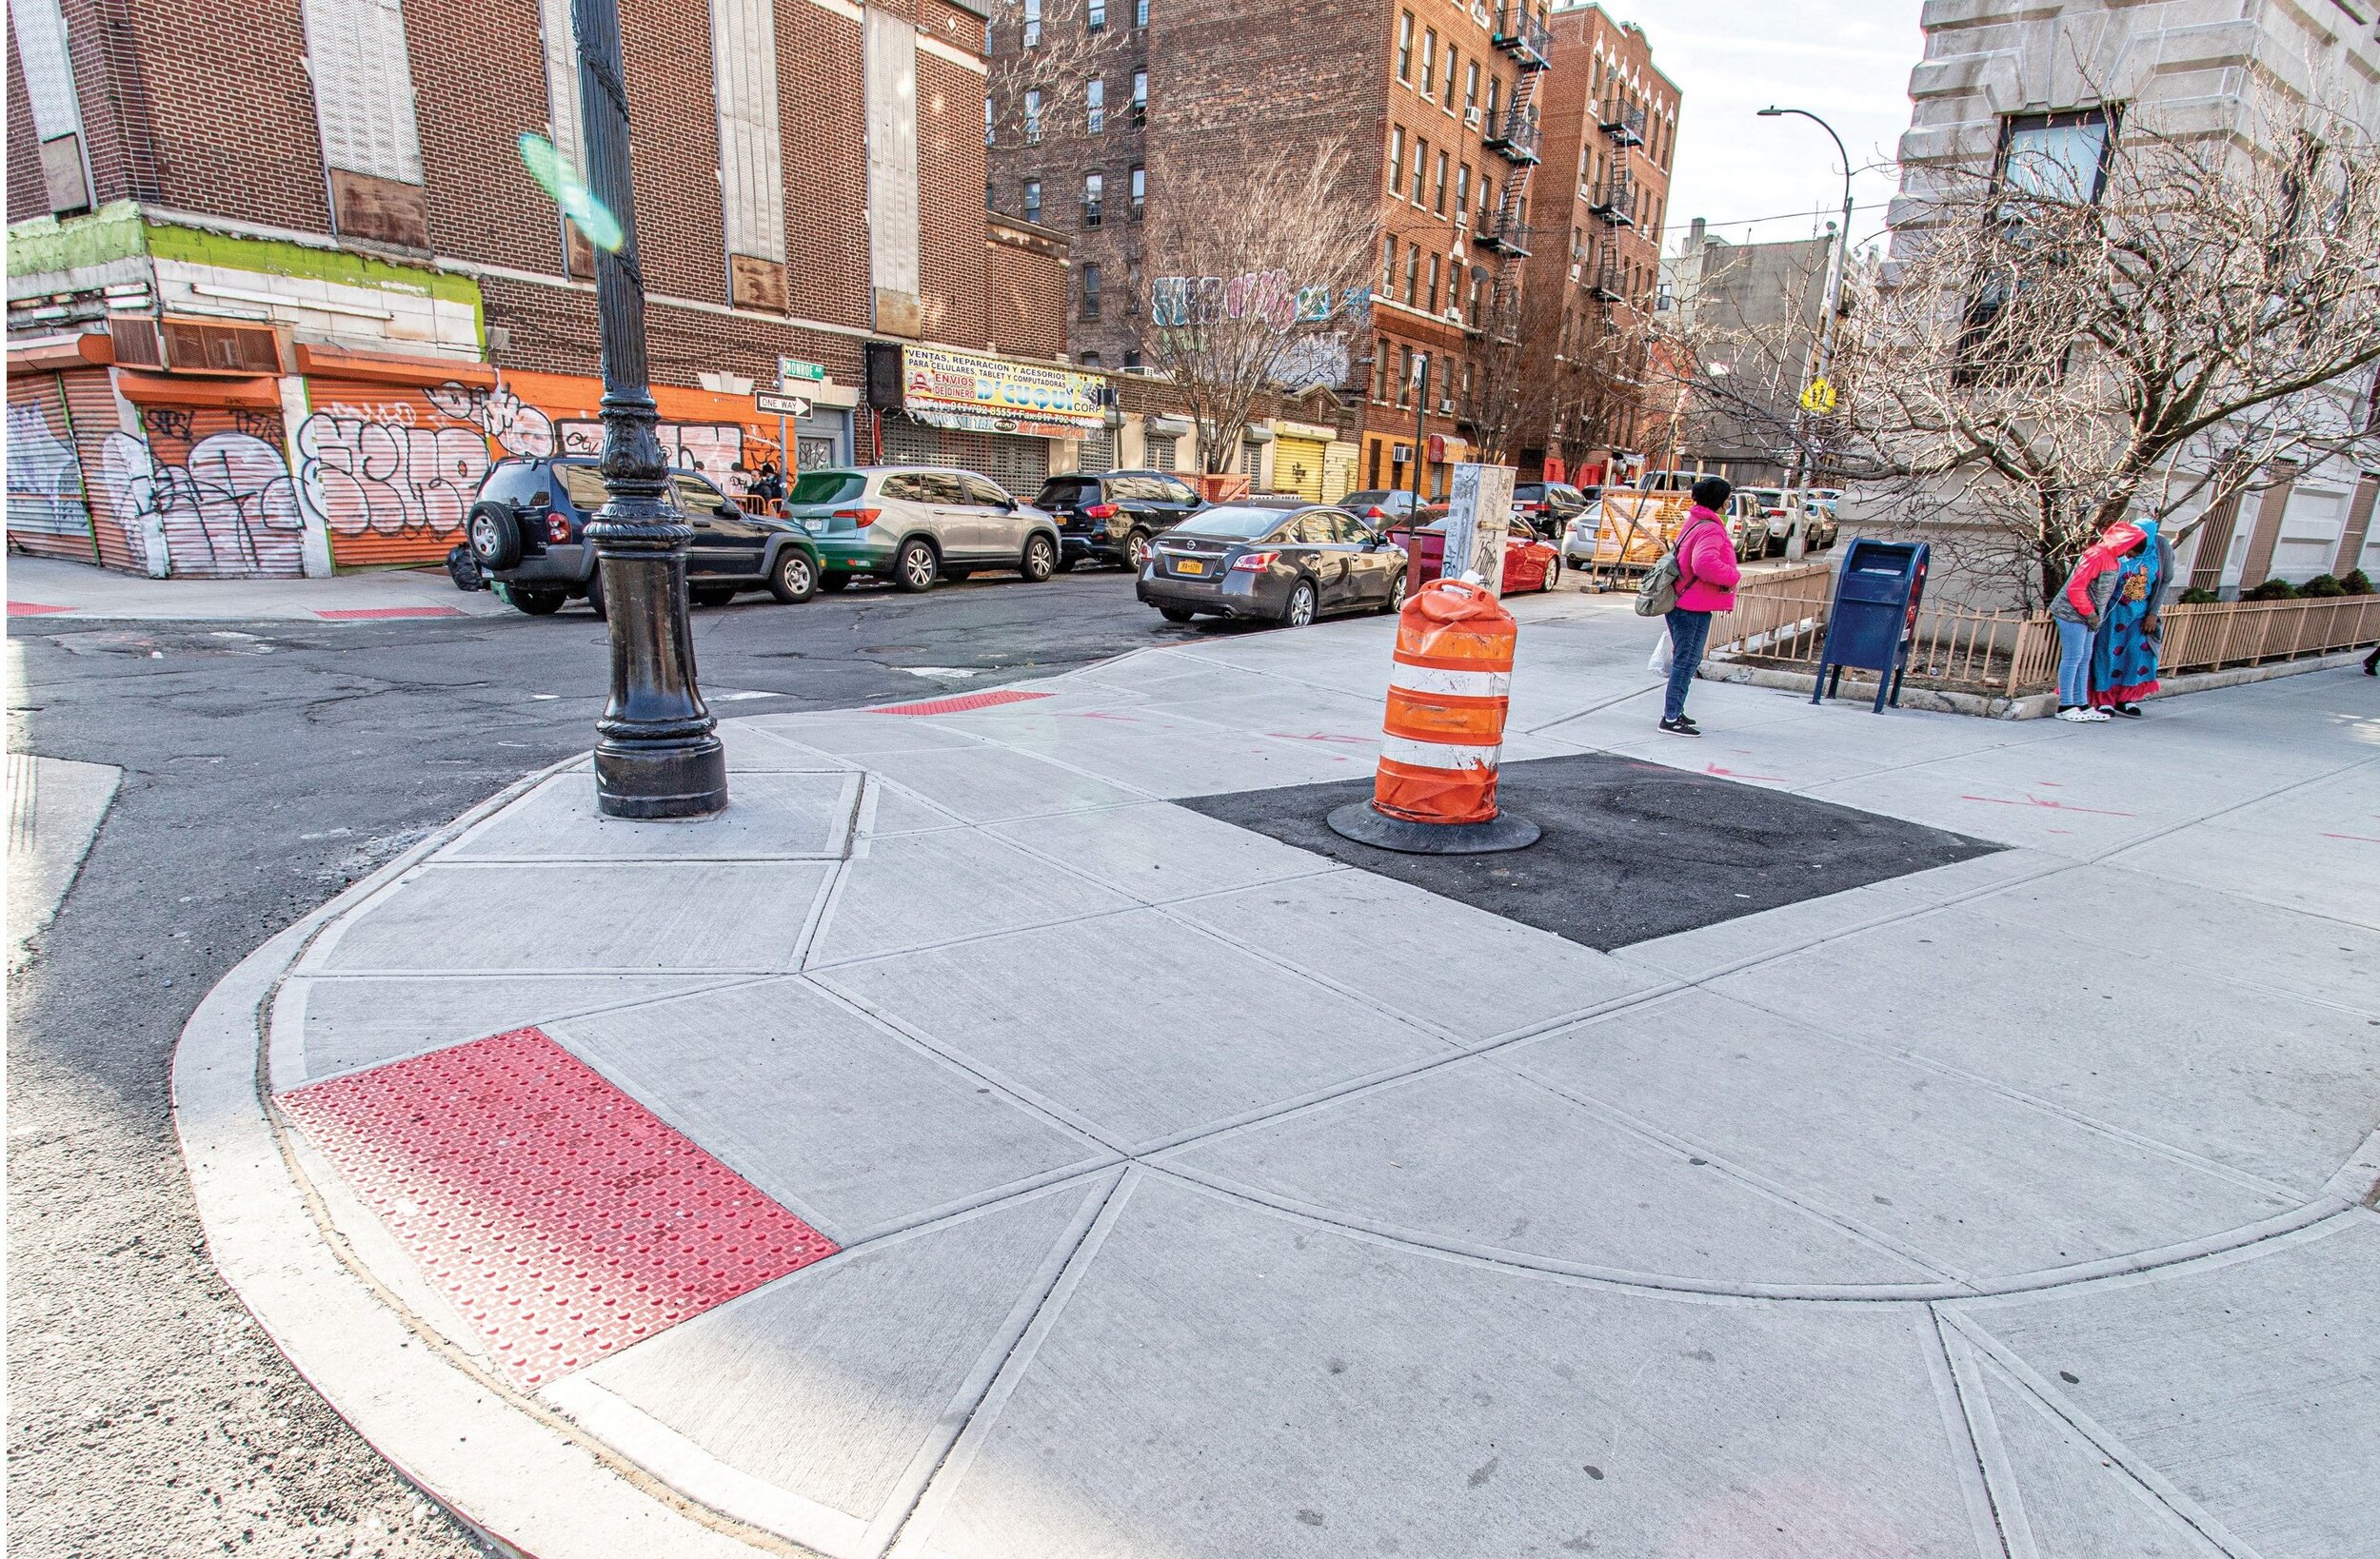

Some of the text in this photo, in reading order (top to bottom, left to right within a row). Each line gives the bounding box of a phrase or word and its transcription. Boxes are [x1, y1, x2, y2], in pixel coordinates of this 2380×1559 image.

[786, 361, 814, 377] MONROE
[909, 349, 949, 363] VENTAS,
[952, 356, 1009, 372] REPARACION
[1020, 367, 1066, 381] ACESORIOS
[908, 359, 929, 368] PARA
[931, 362, 977, 376] CELULARES,
[979, 369, 1005, 380] TABLET
[1013, 375, 1066, 388] COMPUTADORAS
[934, 373, 976, 386] ENVIOS
[934, 385, 976, 400] DE DINERO
[762, 398, 797, 409] ONE WAY
